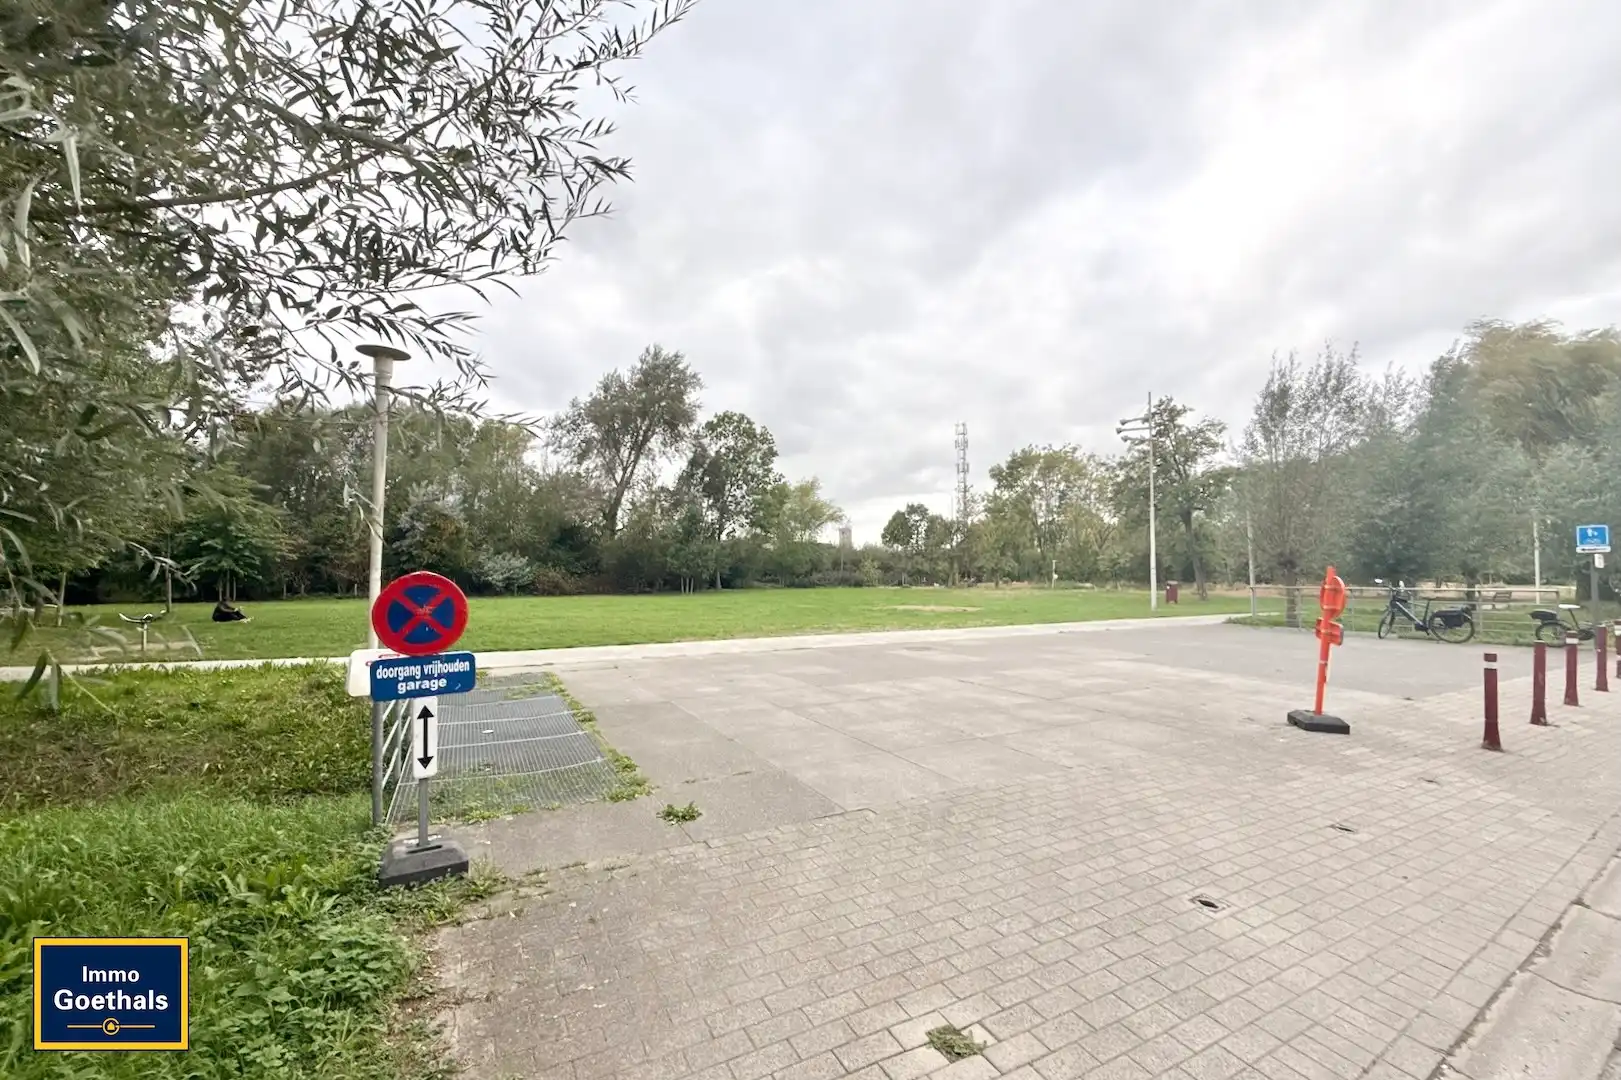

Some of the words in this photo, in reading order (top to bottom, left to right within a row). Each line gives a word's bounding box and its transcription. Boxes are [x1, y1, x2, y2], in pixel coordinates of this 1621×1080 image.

[376, 665, 421, 680] doorgang
[423, 659, 470, 677] vrijhouden
[397, 678, 447, 694] garage
